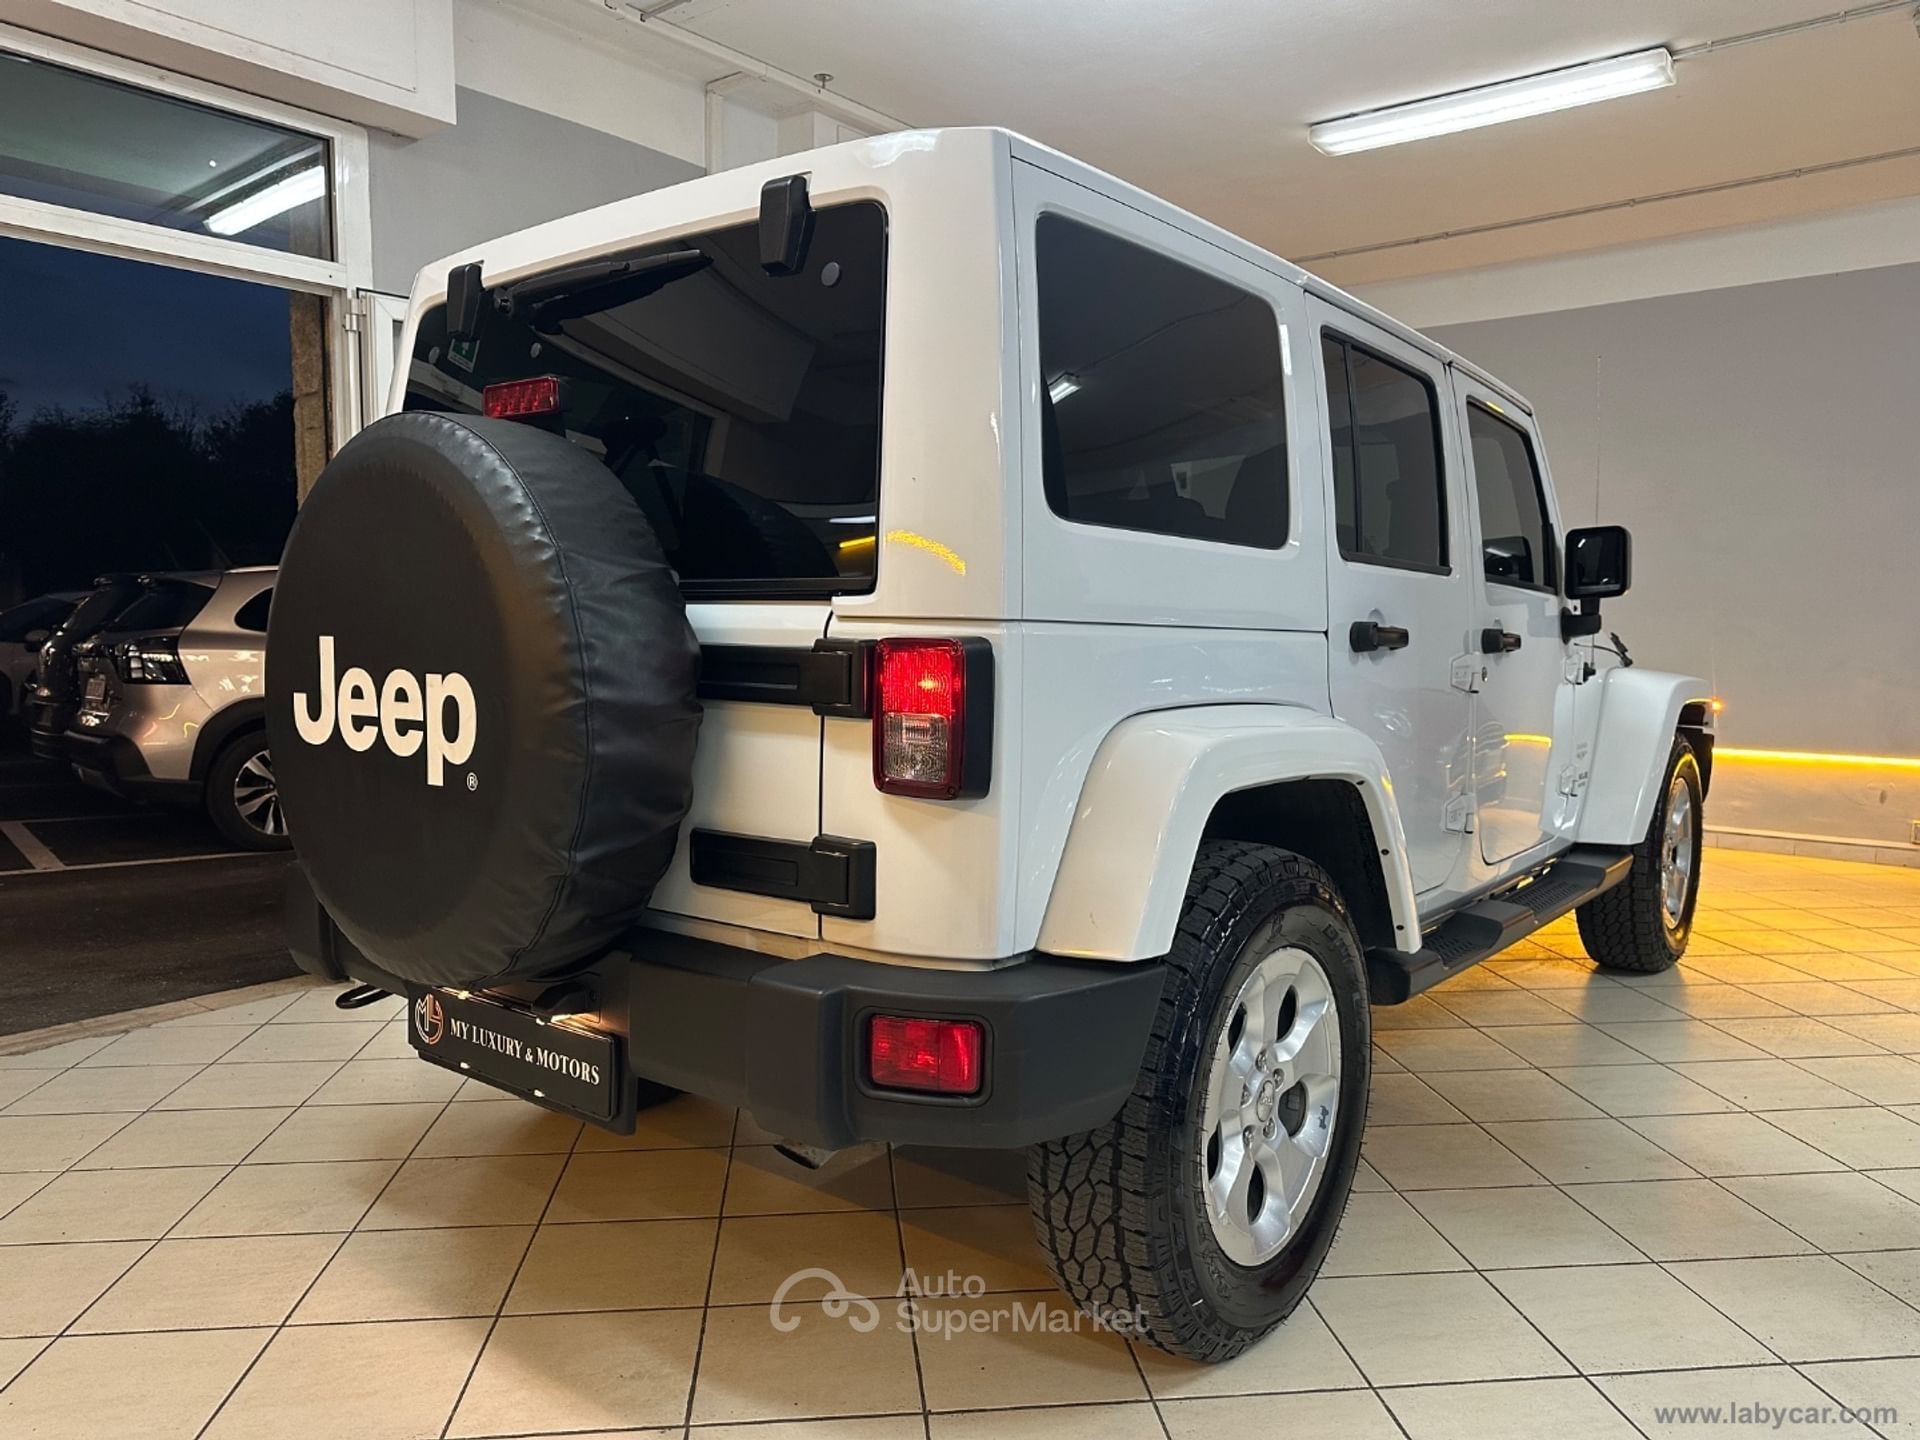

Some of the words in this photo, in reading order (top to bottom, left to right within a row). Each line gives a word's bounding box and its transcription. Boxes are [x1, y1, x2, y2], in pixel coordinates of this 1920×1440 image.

[293, 635, 477, 787] Jeep
[450, 1017, 470, 1040] MY
[472, 1025, 523, 1059] LUXURY
[525, 1047, 534, 1063] &
[536, 1046, 600, 1085] MOTORS
